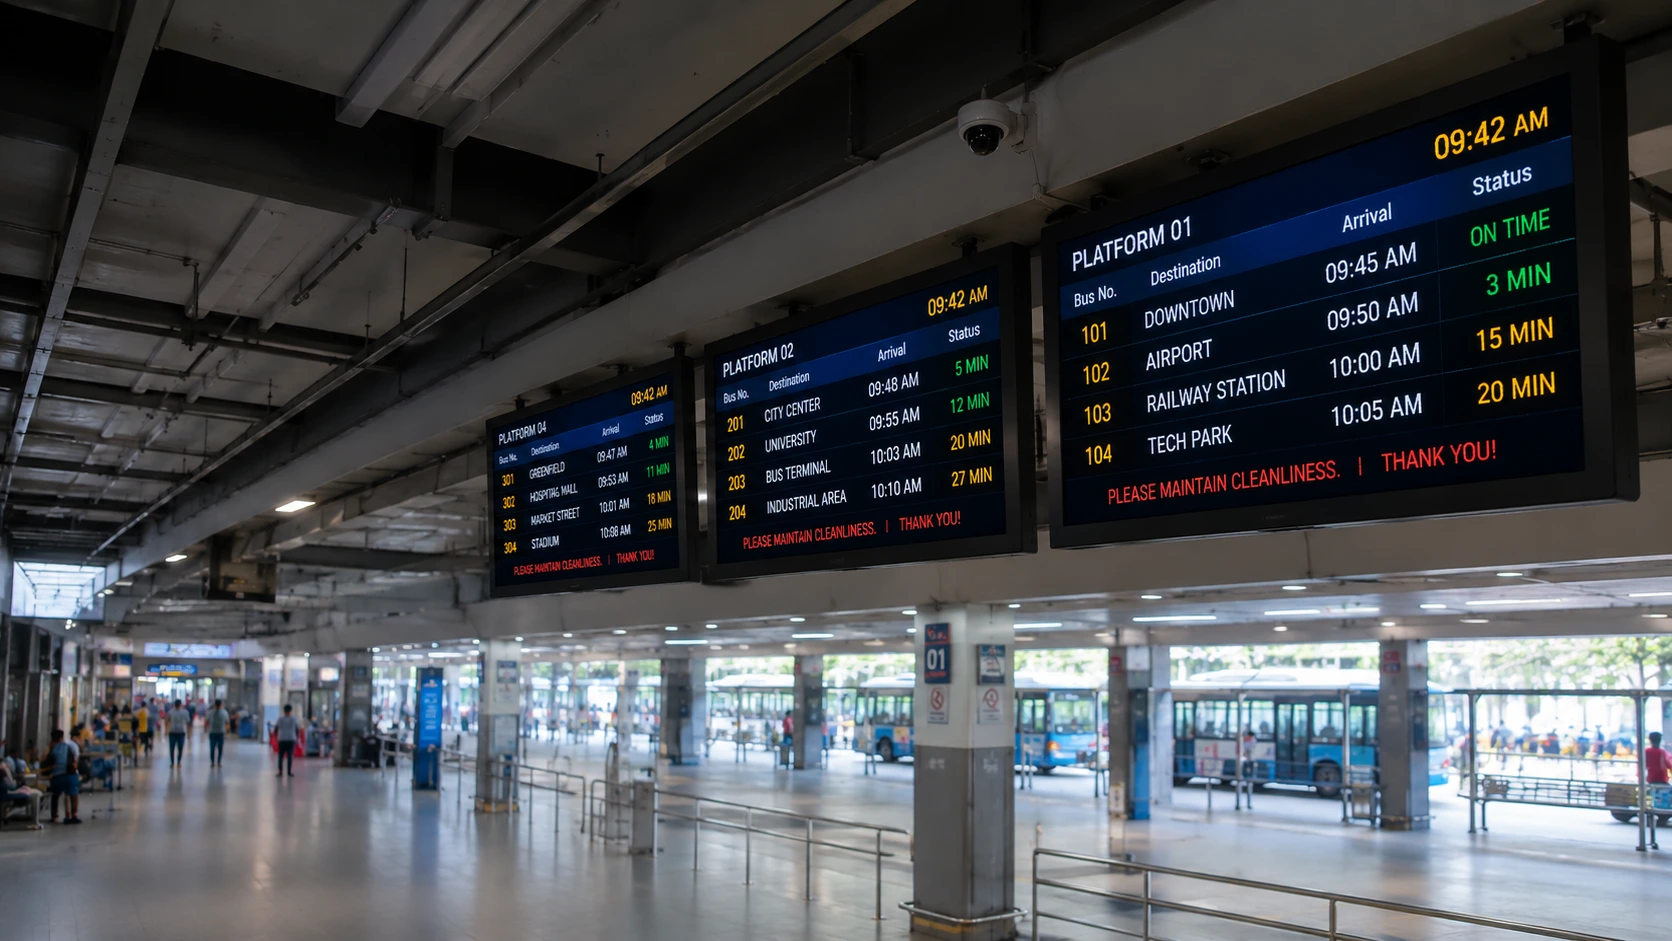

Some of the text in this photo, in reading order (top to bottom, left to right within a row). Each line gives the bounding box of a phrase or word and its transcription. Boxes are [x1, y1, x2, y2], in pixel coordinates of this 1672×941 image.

[1435, 107, 1548, 159] 09:42 AM
[1473, 167, 1532, 195] Status
[1343, 202, 1391, 232] Arrival
[1471, 208, 1550, 246] ON TIME
[1073, 216, 1190, 271] PLATFORM 01
[1151, 256, 1220, 286] Destination
[1326, 242, 1416, 283] 09:45 AM
[1487, 262, 1551, 295] 3 MIN
[928, 285, 987, 316] 09:42 AM
[1075, 286, 1116, 307] Bus No.
[1145, 290, 1234, 328] DOWNTOWN
[1328, 292, 1418, 330] 09:50 AM
[949, 325, 980, 342] Status
[1082, 321, 1106, 344] 101
[1477, 317, 1553, 351] 15 MIN
[724, 343, 793, 377] PLATFORM 02
[878, 342, 906, 361] Arrival
[1146, 339, 1212, 370] AIRPORT
[1330, 342, 1420, 378] 10:00 AM
[956, 355, 988, 376] 5 MIN
[1083, 362, 1109, 384] 102
[769, 373, 809, 391] Destination
[869, 372, 918, 397] 09:48 AM
[1147, 369, 1285, 412] RAILWAY STATION
[1478, 372, 1555, 404] 20 MIN
[632, 385, 667, 405] 09:42 AM
[724, 389, 749, 403] Bus No.
[951, 392, 989, 413] 12 MIN
[645, 413, 663, 425] Status
[765, 397, 820, 422] CITY CENTER
[870, 406, 919, 430] 09:55 AM
[1085, 403, 1111, 424] 103
[1332, 393, 1422, 426] 10:05 AM
[499, 421, 546, 445] PLATFORM 04
[602, 423, 619, 436] Arrival
[728, 415, 743, 432] 201
[649, 436, 668, 449] 4 MIN
[765, 430, 816, 452] UNIVERSITY
[951, 429, 990, 450] 20 MIN
[1148, 425, 1232, 454] TECH PARK
[597, 446, 627, 462] 09:47 AM
[728, 444, 744, 461] 202
[871, 442, 920, 464] 10:03 AM
[1086, 444, 1112, 465] 104
[502, 474, 514, 486] 301
[530, 461, 565, 479] GREENFIELD
[618, 472, 628, 483] AM
[647, 463, 669, 477] 11 MIN
[766, 460, 831, 483] BUS TERMINAL
[952, 466, 992, 486] 27 MIN
[1108, 483, 1156, 504] PLEASE
[1160, 474, 1226, 498] MAINTAIN
[1232, 460, 1340, 490] CLEANLINESS.
[1381, 446, 1445, 471] THANK
[1450, 440, 1496, 464] YOU!
[561, 483, 578, 495] MALL
[729, 474, 745, 490] 203
[872, 477, 921, 498] 10:10 AM
[503, 496, 515, 508] 302
[600, 498, 629, 513] 10:01 AM
[648, 490, 671, 504] 18 MIN
[767, 490, 846, 513] INDUSTRIAL AREA
[531, 507, 580, 525] MARKET STREET
[729, 505, 746, 520] 204
[504, 519, 516, 531] 303
[620, 524, 631, 535] AM
[648, 518, 672, 532] 25 MIN
[743, 535, 772, 549] PLEASE
[774, 530, 812, 545] MAINTAIN
[815, 522, 876, 541] CLEANLINESS.
[900, 515, 933, 530] THANK
[936, 511, 960, 526] YOU!
[504, 542, 517, 554] 304
[532, 536, 559, 549] STADIUM
[514, 564, 534, 575] PLEASE
[616, 552, 638, 563] THANK
[927, 648, 945, 670] 01
